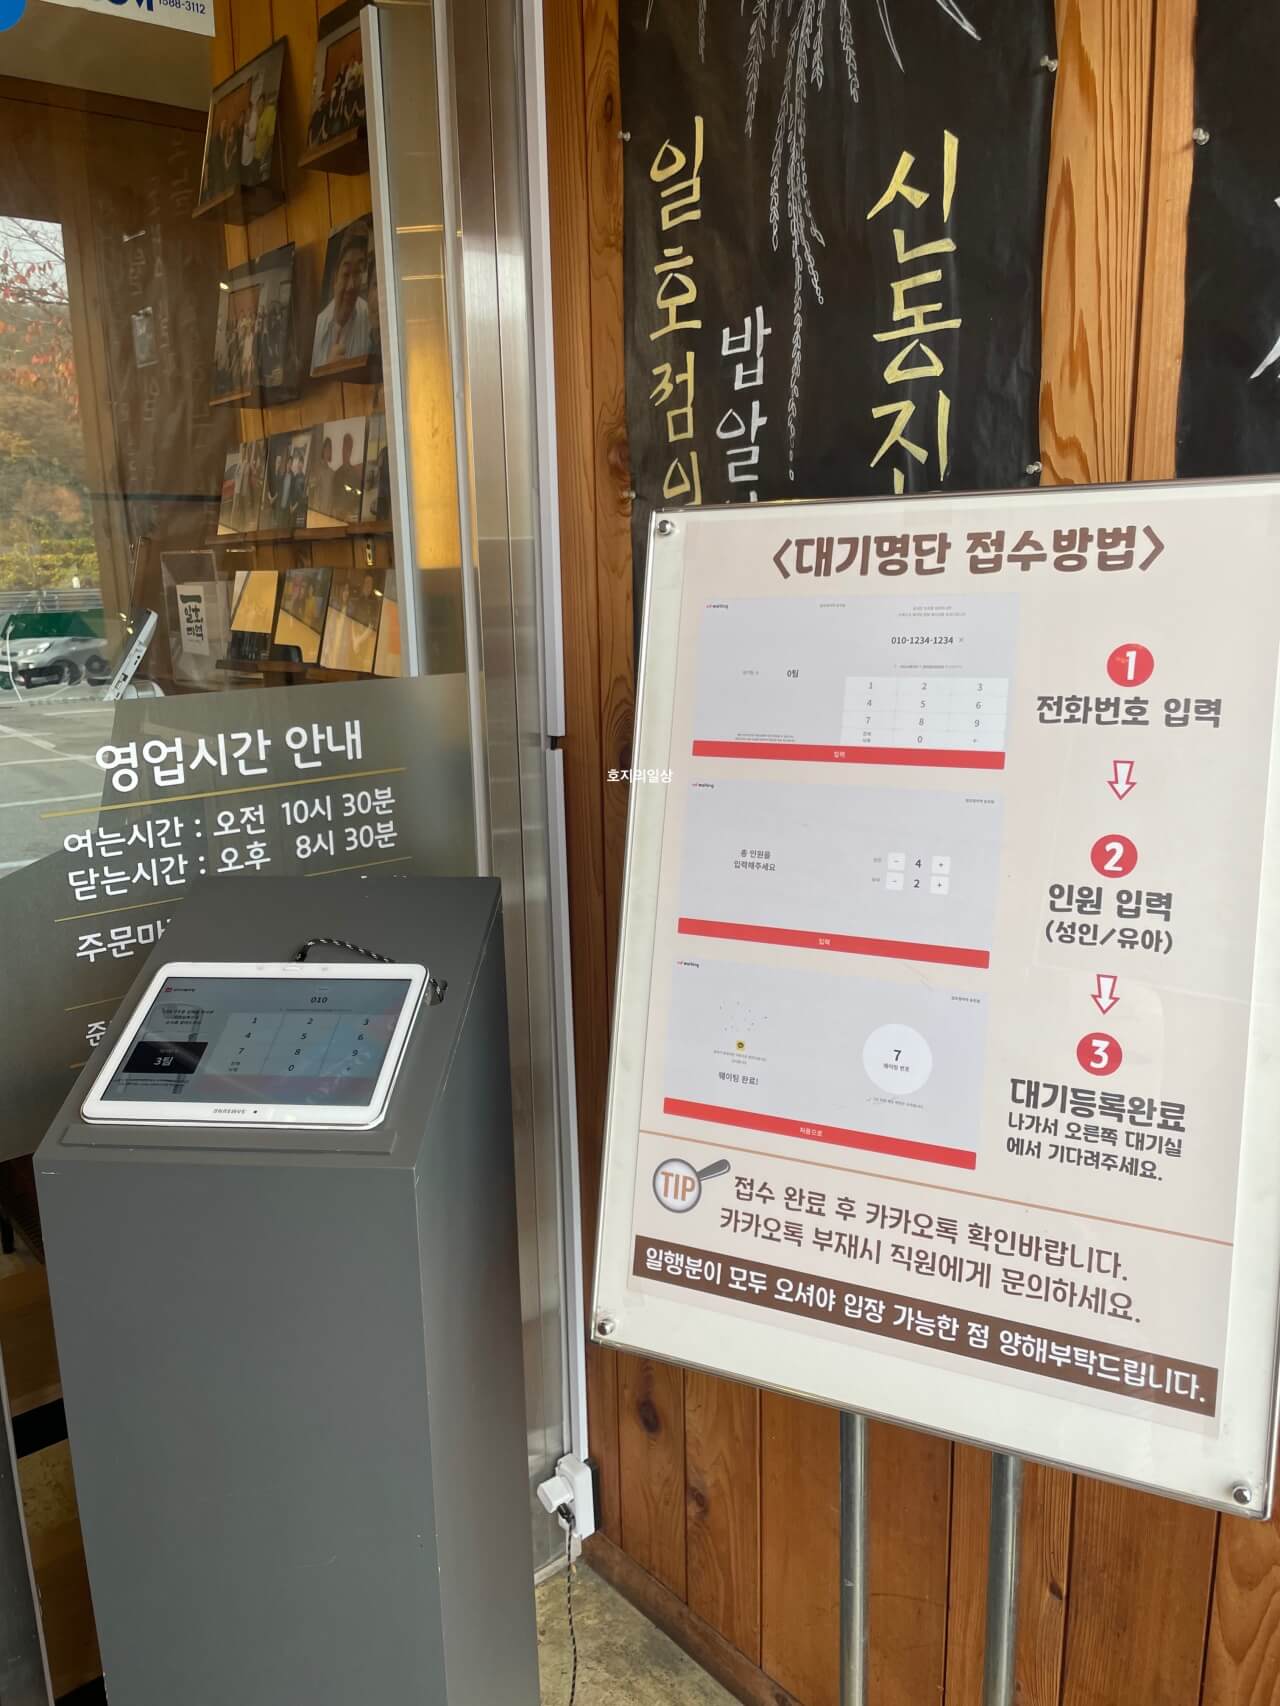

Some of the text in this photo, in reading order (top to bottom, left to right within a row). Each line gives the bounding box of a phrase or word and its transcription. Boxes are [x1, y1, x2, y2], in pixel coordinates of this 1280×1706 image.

[715, 304, 773, 502] 밥알
[891, 636, 954, 645] 010-1234-1234
[1124, 650, 1138, 682] 1
[921, 682, 928, 690] 2
[977, 683, 984, 691] 3
[866, 699, 982, 710] 4 5 6
[1036, 694, 1222, 729] 전화번호 입력
[974, 719, 980, 727] 9
[917, 735, 923, 744] 0
[95, 719, 363, 793] 영업시간 안내
[63, 815, 185, 859] 여는시간
[212, 804, 267, 837] 오전
[281, 794, 333, 826] 10시
[342, 787, 397, 818] 30분
[68, 853, 189, 901] 닫는시간
[216, 841, 272, 873] 오후
[295, 829, 336, 860] 8시
[345, 820, 398, 851] 30분
[734, 860, 776, 872] 입력해주세요
[750, 849, 771, 860] 인원을
[915, 859, 922, 868] 4
[1103, 841, 1125, 872] 2
[913, 879, 920, 888] 2
[1048, 883, 1173, 922] 인원 입력
[76, 919, 172, 962] 주문마
[1045, 919, 1174, 955] (성인/유아)
[310, 996, 328, 1004] 010
[288, 1064, 295, 1072] 0
[893, 1049, 902, 1062] 7
[1089, 1039, 1110, 1069] 3
[718, 1071, 759, 1085] 웨이팅 완료!
[1010, 1078, 1186, 1133] 대기등록완료
[1007, 1111, 1183, 1158] 나가서 오른쪽 대기실
[1006, 1136, 1163, 1181] 에서 기다려주세요.
[660, 1170, 696, 1202] TIP
[734, 1176, 1129, 1281] 접수 완료 후 카카오톡 확인바랍니다.
[720, 1207, 1142, 1323] 카카오톡 부재시 직원에게 문의하세요.
[645, 1247, 1206, 1402] 일행분이 모두 오셔야 입장 가능한 점 양해부탁드립니다.
